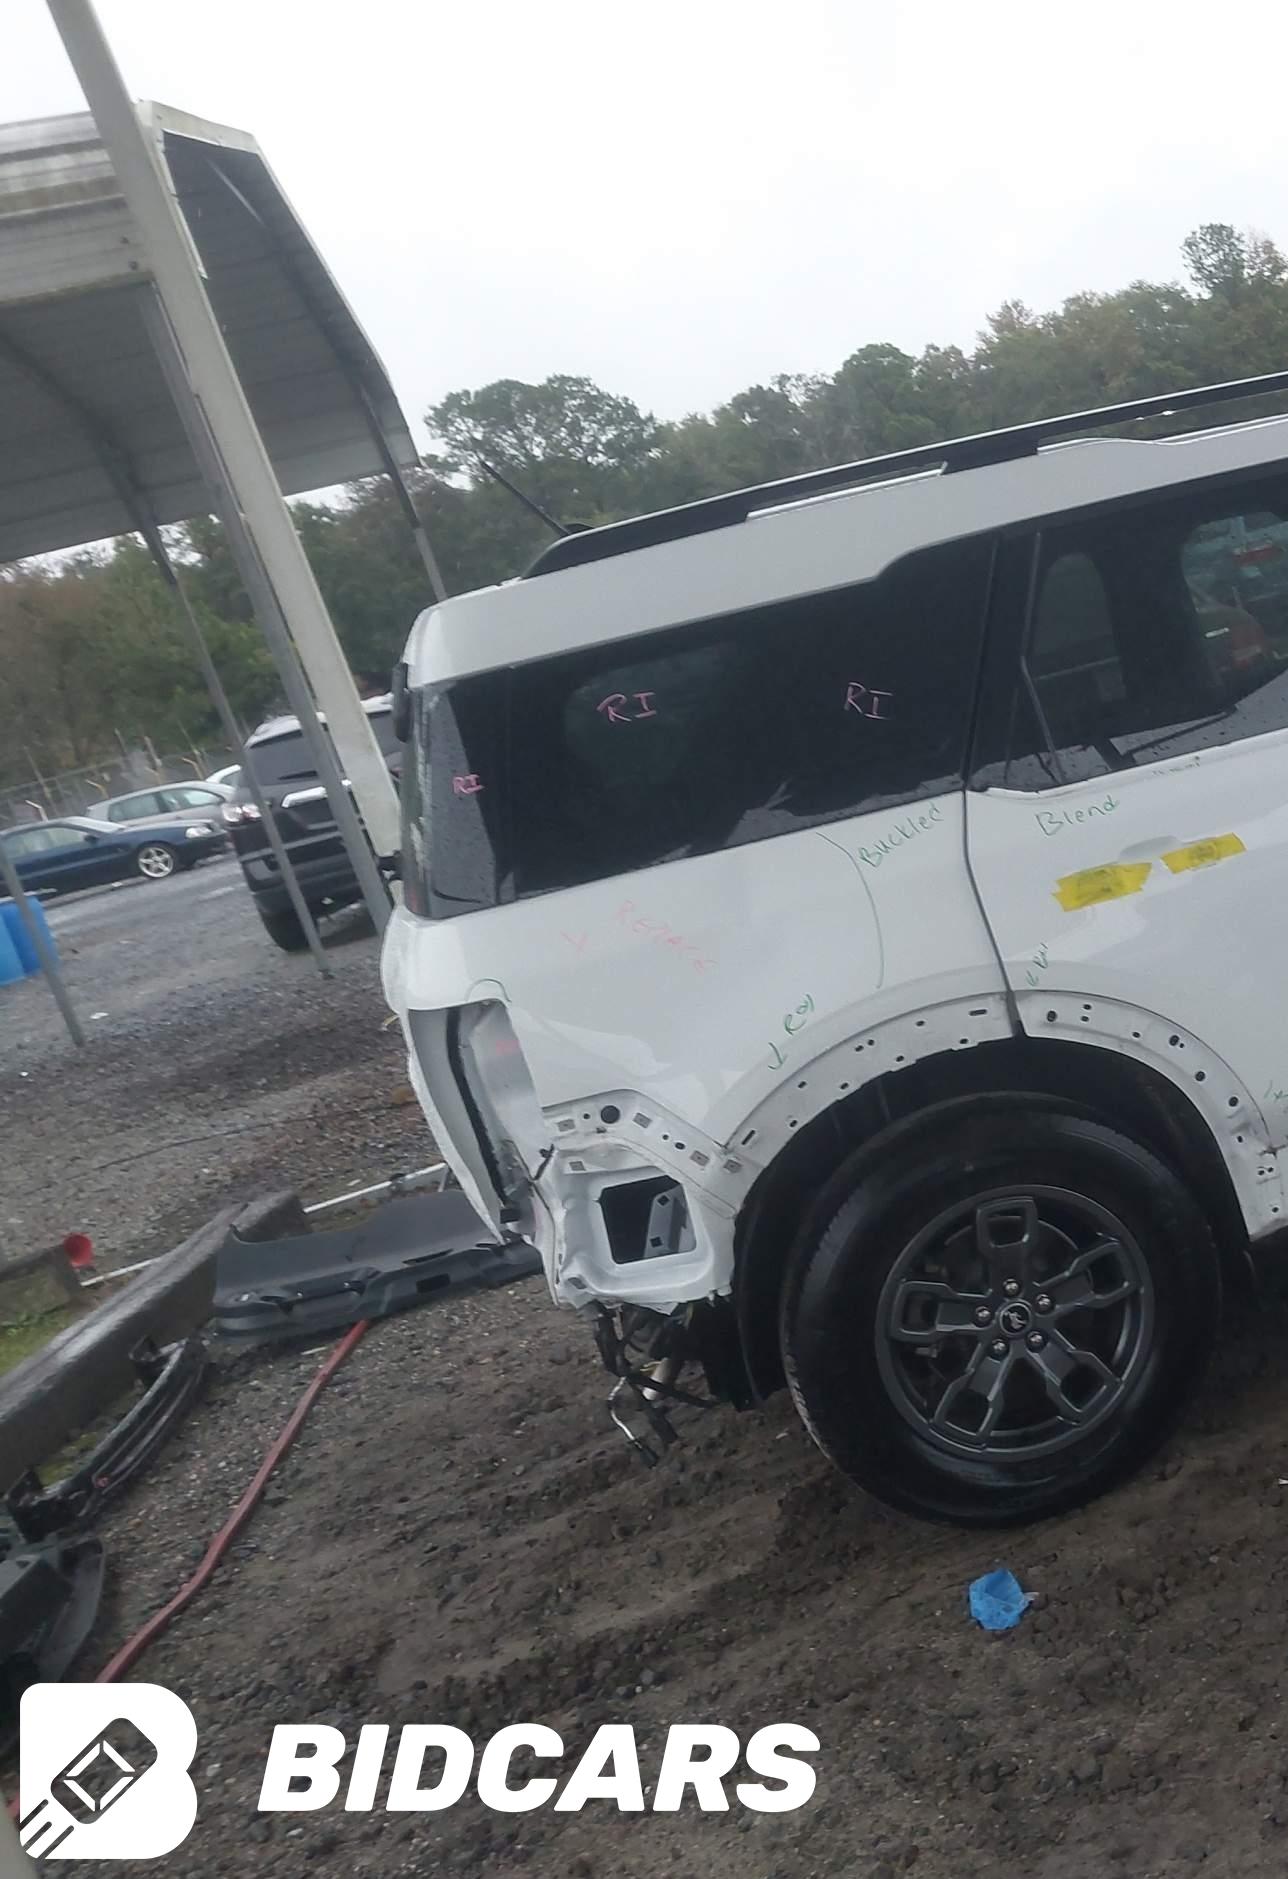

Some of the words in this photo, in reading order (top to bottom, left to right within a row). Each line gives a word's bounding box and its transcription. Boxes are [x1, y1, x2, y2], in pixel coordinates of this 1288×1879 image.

[597, 691, 656, 722] RI
[844, 681, 893, 720] RI
[1035, 794, 1119, 836] Blend
